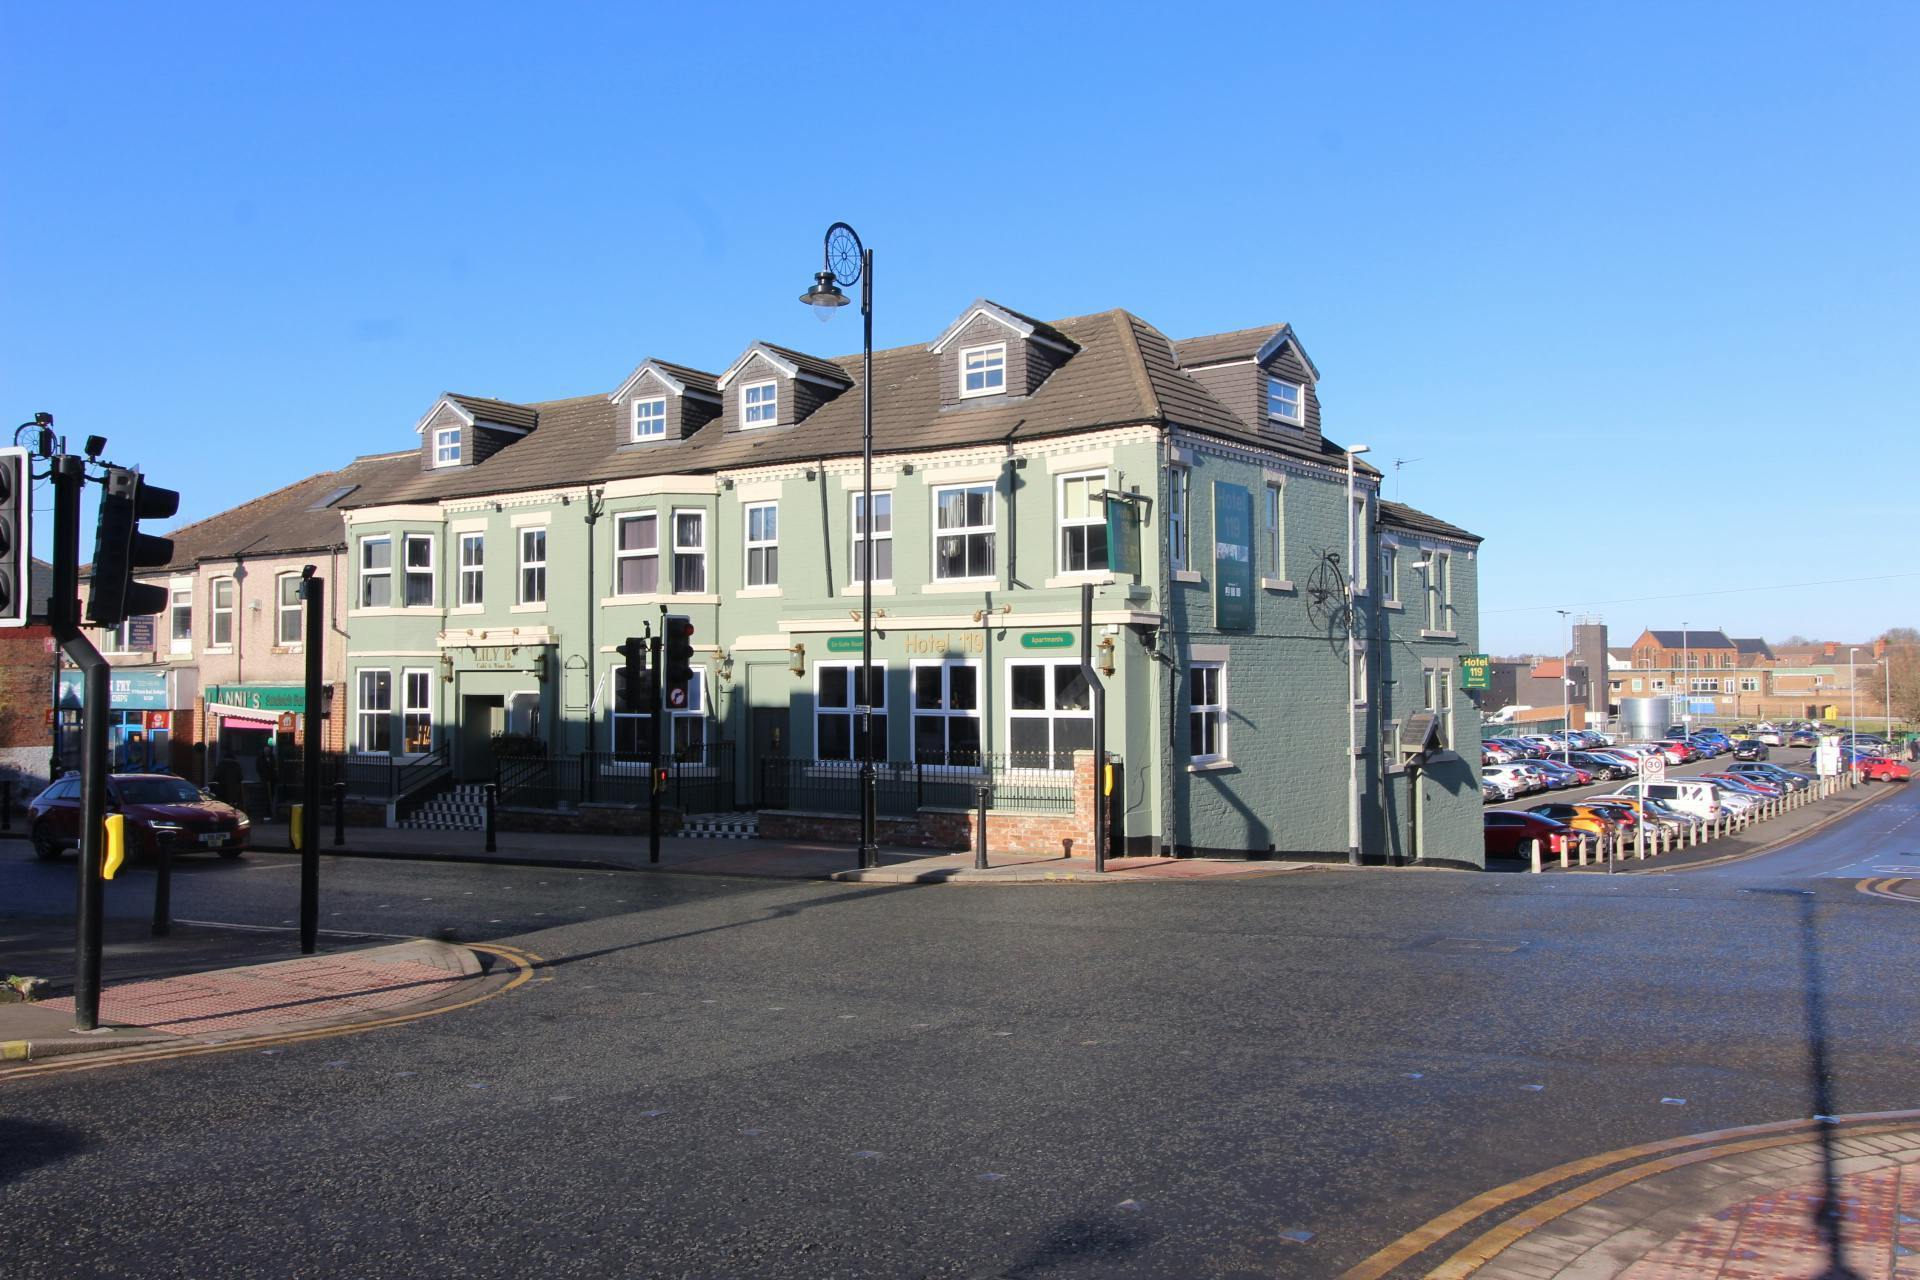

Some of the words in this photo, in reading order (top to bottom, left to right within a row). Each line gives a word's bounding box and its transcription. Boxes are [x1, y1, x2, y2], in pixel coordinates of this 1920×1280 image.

[1216, 484, 1247, 512] Hotel
[1223, 516, 1241, 538] 119
[904, 632, 950, 653] Hotel
[959, 631, 984, 653] 119
[1031, 636, 1064, 644] Apartments
[1464, 657, 1488, 667] Hotel
[1470, 667, 1483, 676] 119
[115, 680, 132, 691] FRY
